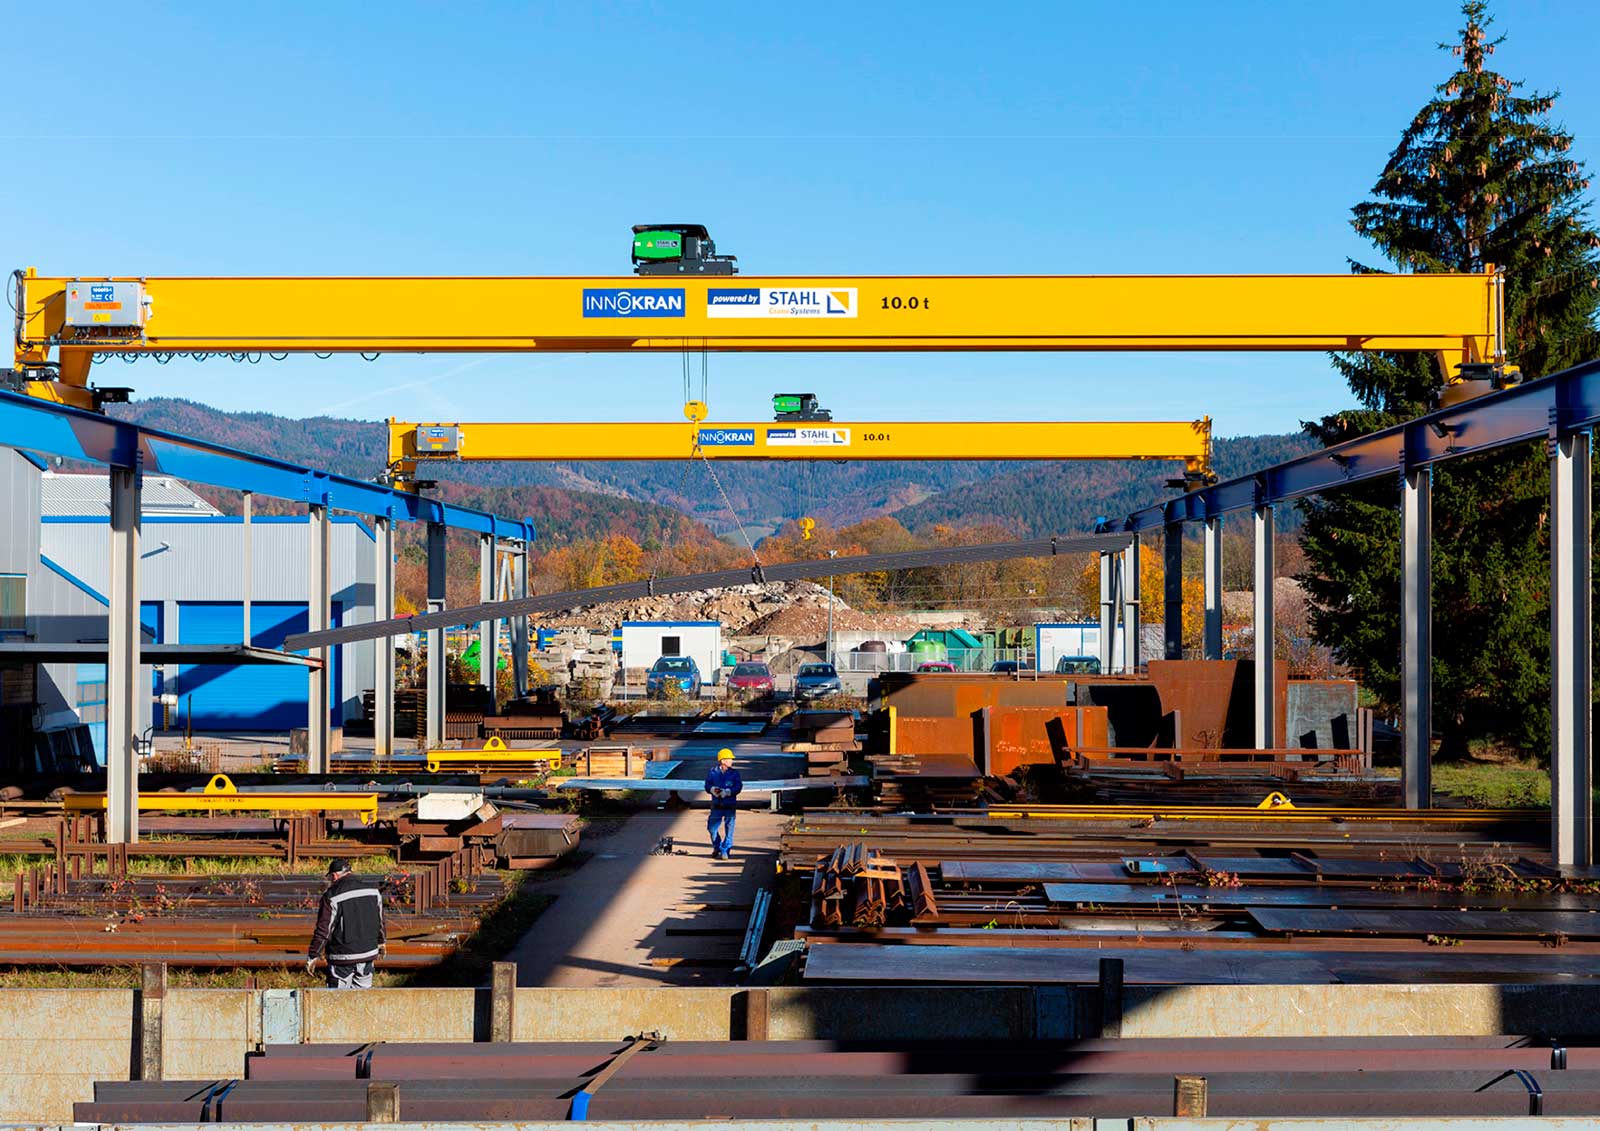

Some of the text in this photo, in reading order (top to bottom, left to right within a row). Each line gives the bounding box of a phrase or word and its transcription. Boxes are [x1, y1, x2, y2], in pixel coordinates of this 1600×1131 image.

[586, 294, 682, 312] INNOKRAN
[712, 291, 820, 305] powered by STAHL
[881, 296, 930, 310] 10.0 t
[790, 307, 820, 316] Systems
[699, 432, 753, 443] INNOKRAN
[801, 430, 830, 439] STAHL
[863, 433, 885, 442] 10.0
